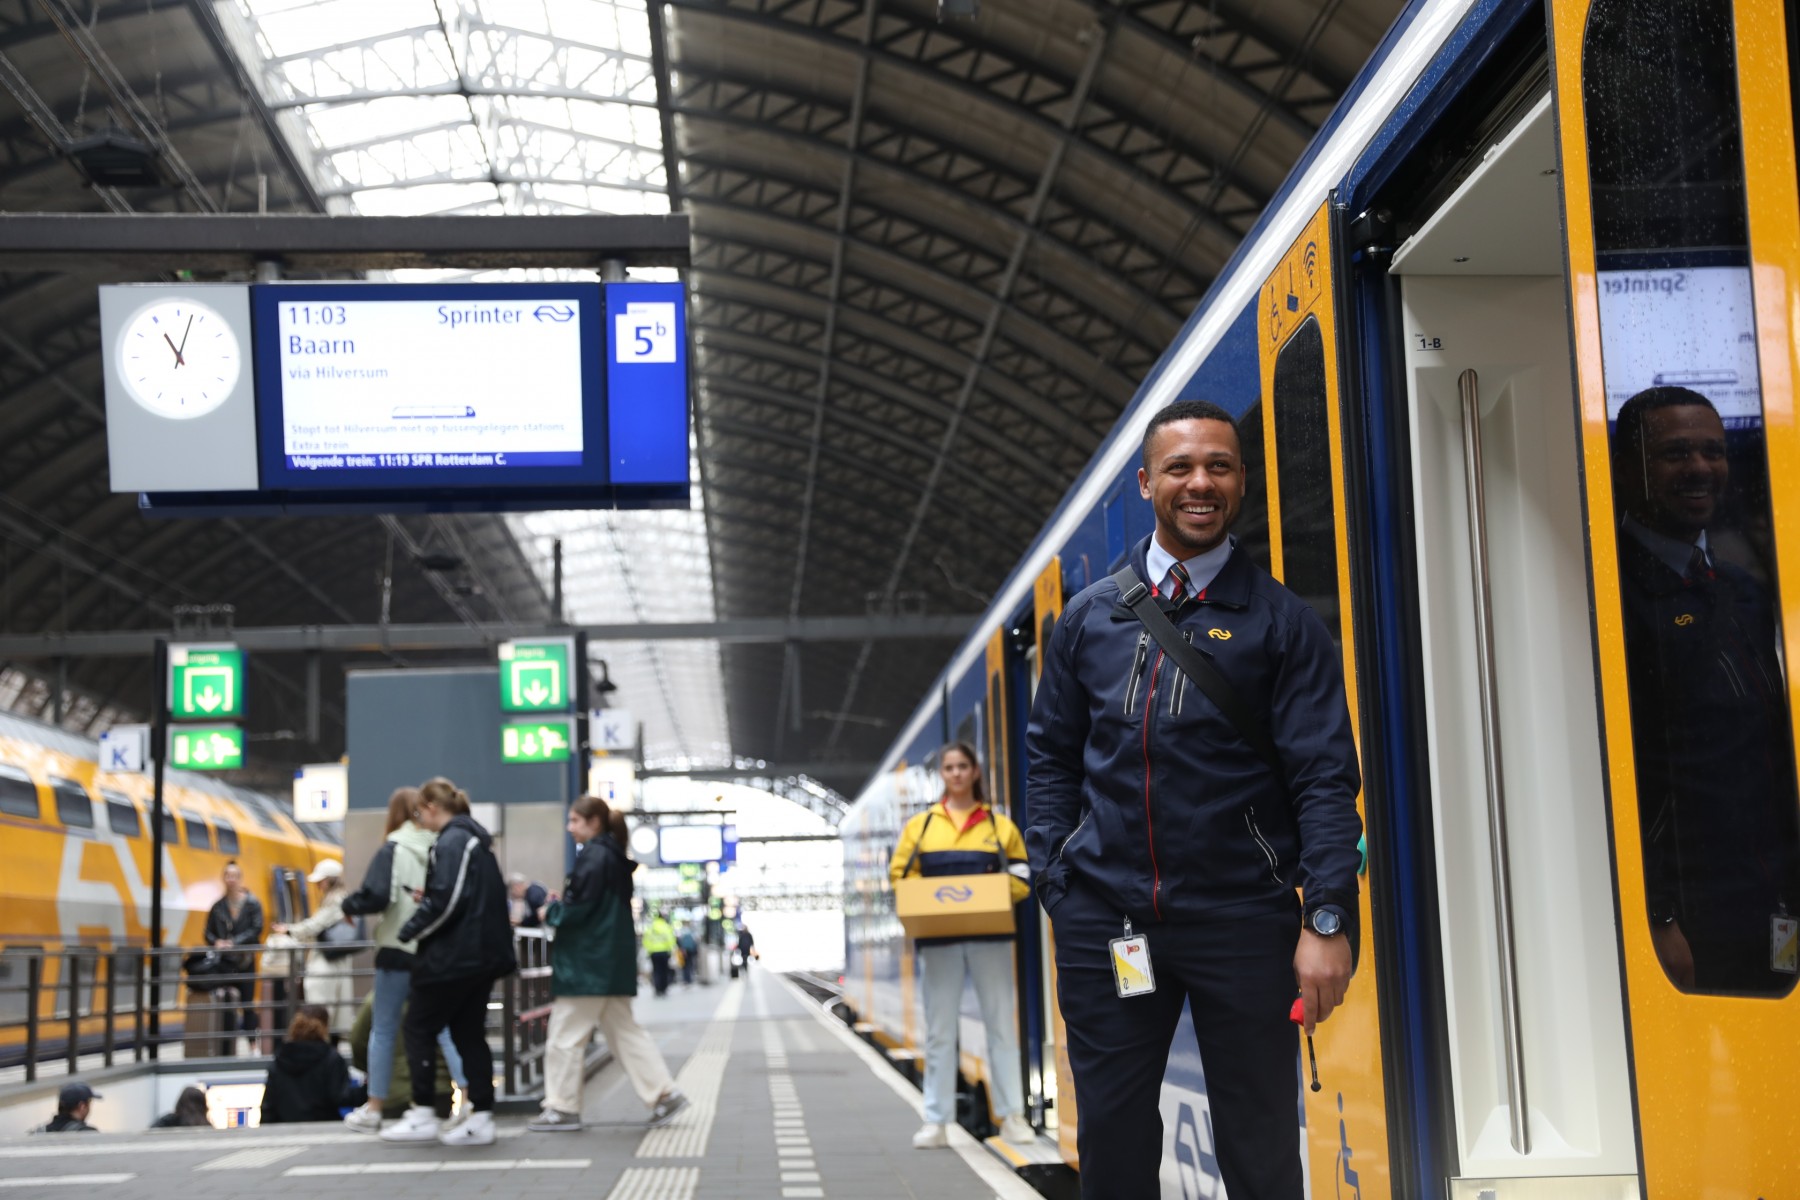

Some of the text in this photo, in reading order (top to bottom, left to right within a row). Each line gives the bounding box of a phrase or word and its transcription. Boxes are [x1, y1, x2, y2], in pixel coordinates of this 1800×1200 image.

[289, 306, 346, 325] 11:03
[438, 304, 522, 329] Sprinter
[289, 335, 355, 354] Baarn
[1420, 338, 1441, 348] 1-B
[289, 365, 389, 379] via Hilversum
[292, 454, 345, 470] Volgende
[379, 454, 410, 467] 11:19
[411, 453, 434, 467] SPR
[435, 453, 494, 466] Rotterdam
[495, 452, 507, 465] C.
[603, 723, 620, 744] K
[112, 746, 128, 769] K
